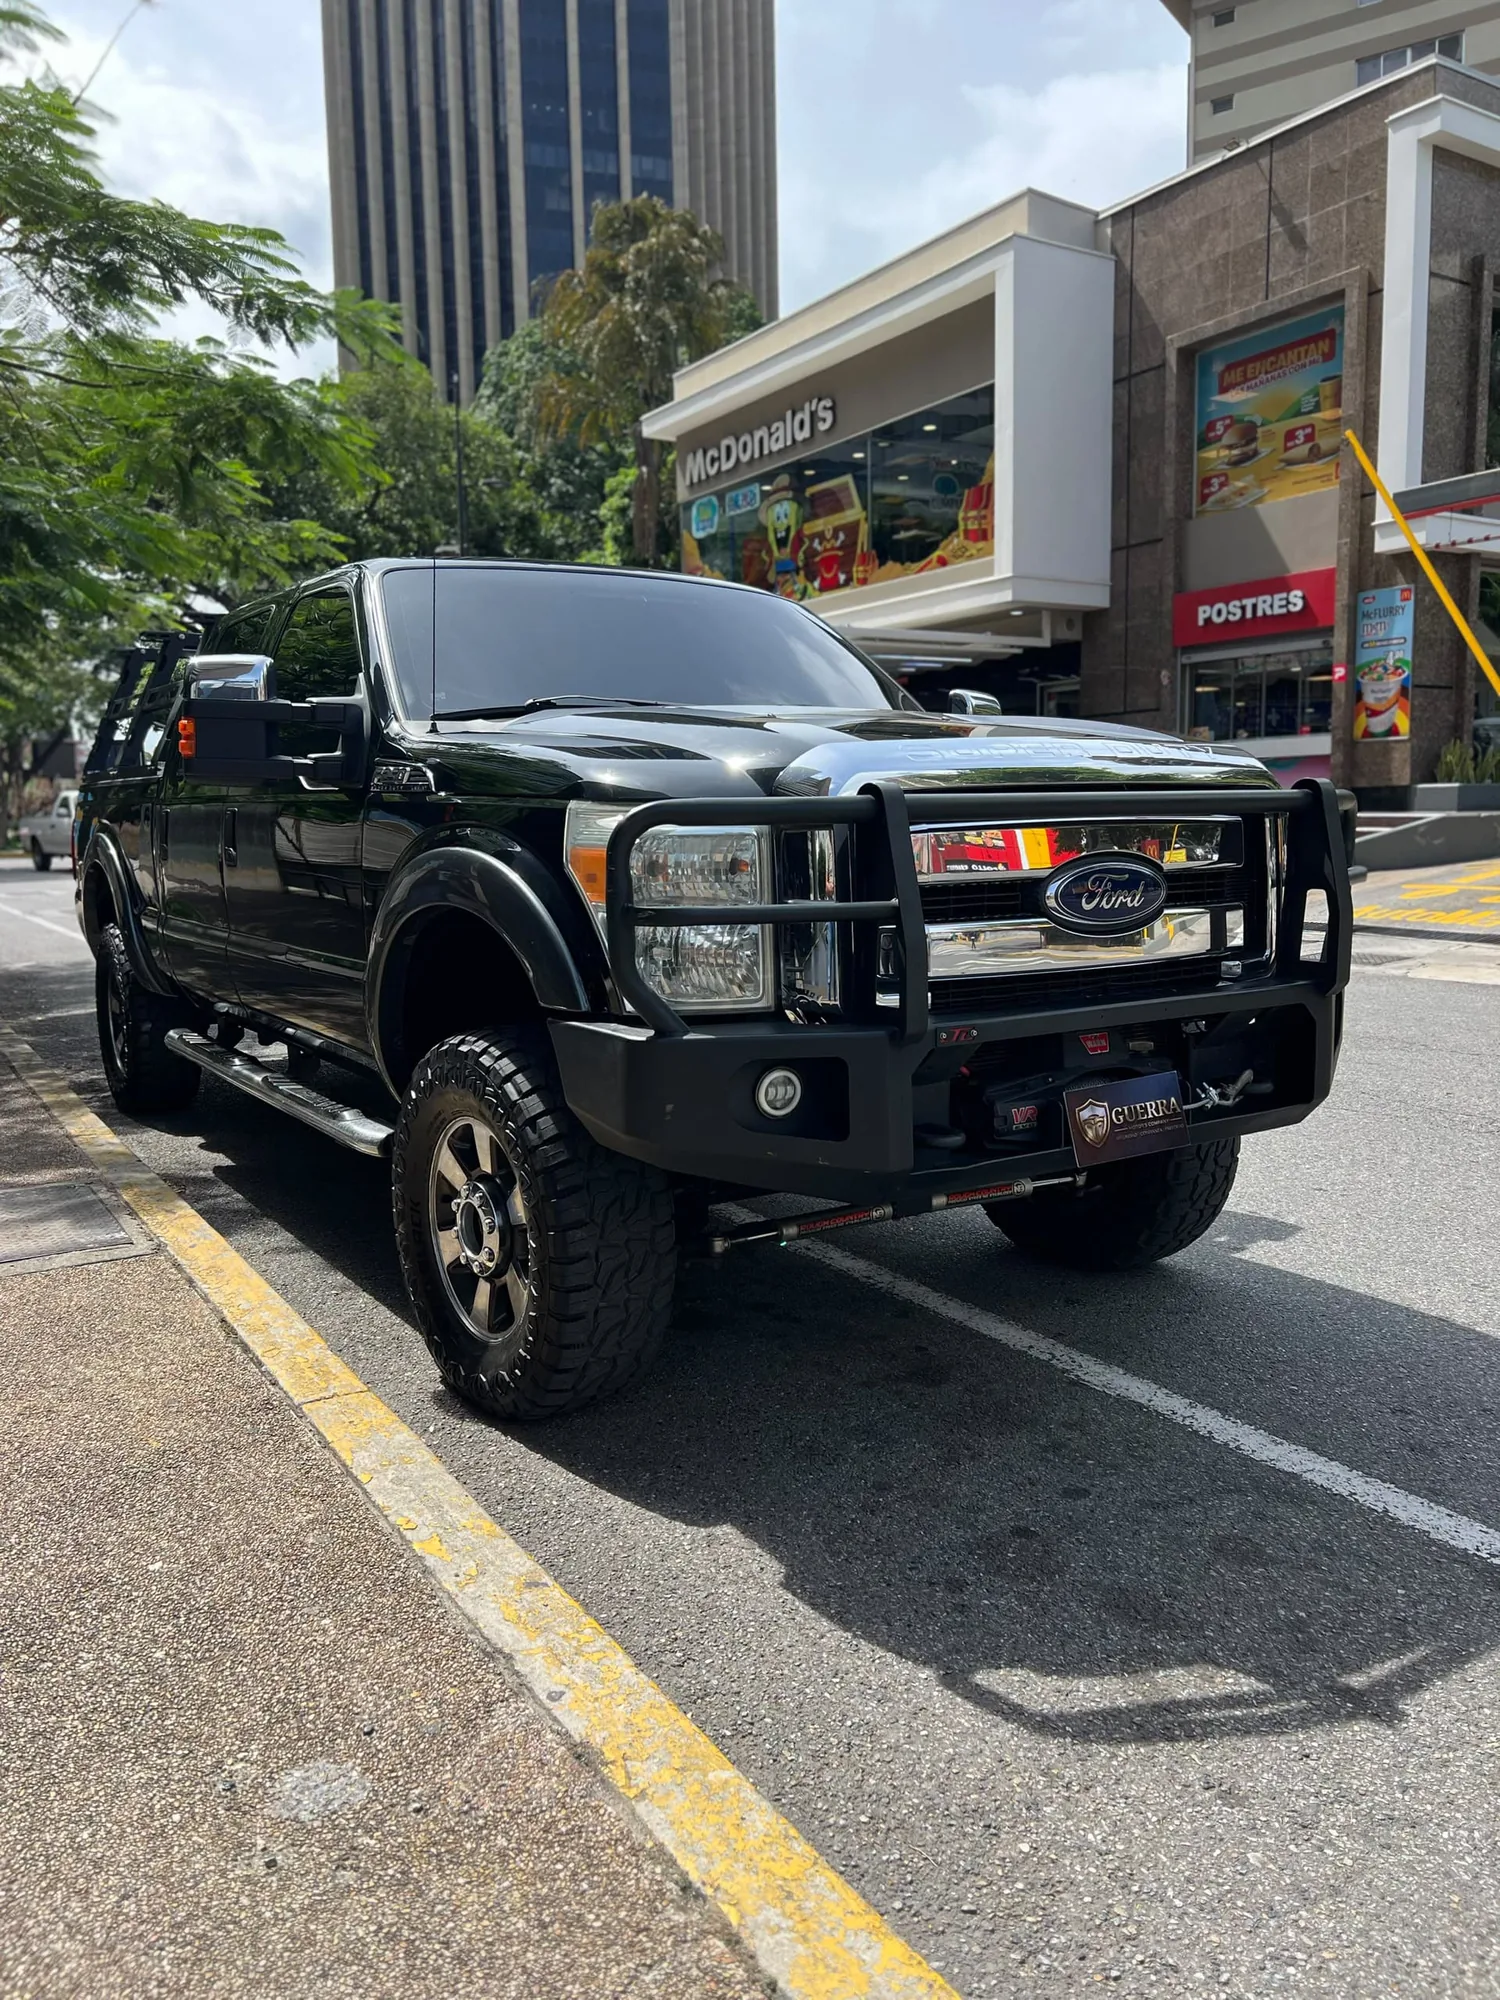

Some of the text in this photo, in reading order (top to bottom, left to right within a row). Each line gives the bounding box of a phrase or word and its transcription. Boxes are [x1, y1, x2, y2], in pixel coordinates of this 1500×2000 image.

[1222, 337, 1330, 387] ME ENCANTAN
[685, 396, 834, 487] McDonald's
[1197, 589, 1304, 627] POSTRES
[1361, 604, 1407, 621] McFLURRY
[1081, 873, 1146, 911] Ford
[1085, 1038, 1107, 1049] WARN
[1012, 1105, 1038, 1124] VR
[1111, 1096, 1182, 1125] GUERRA
[830, 1211, 870, 1225] COUNTRY
